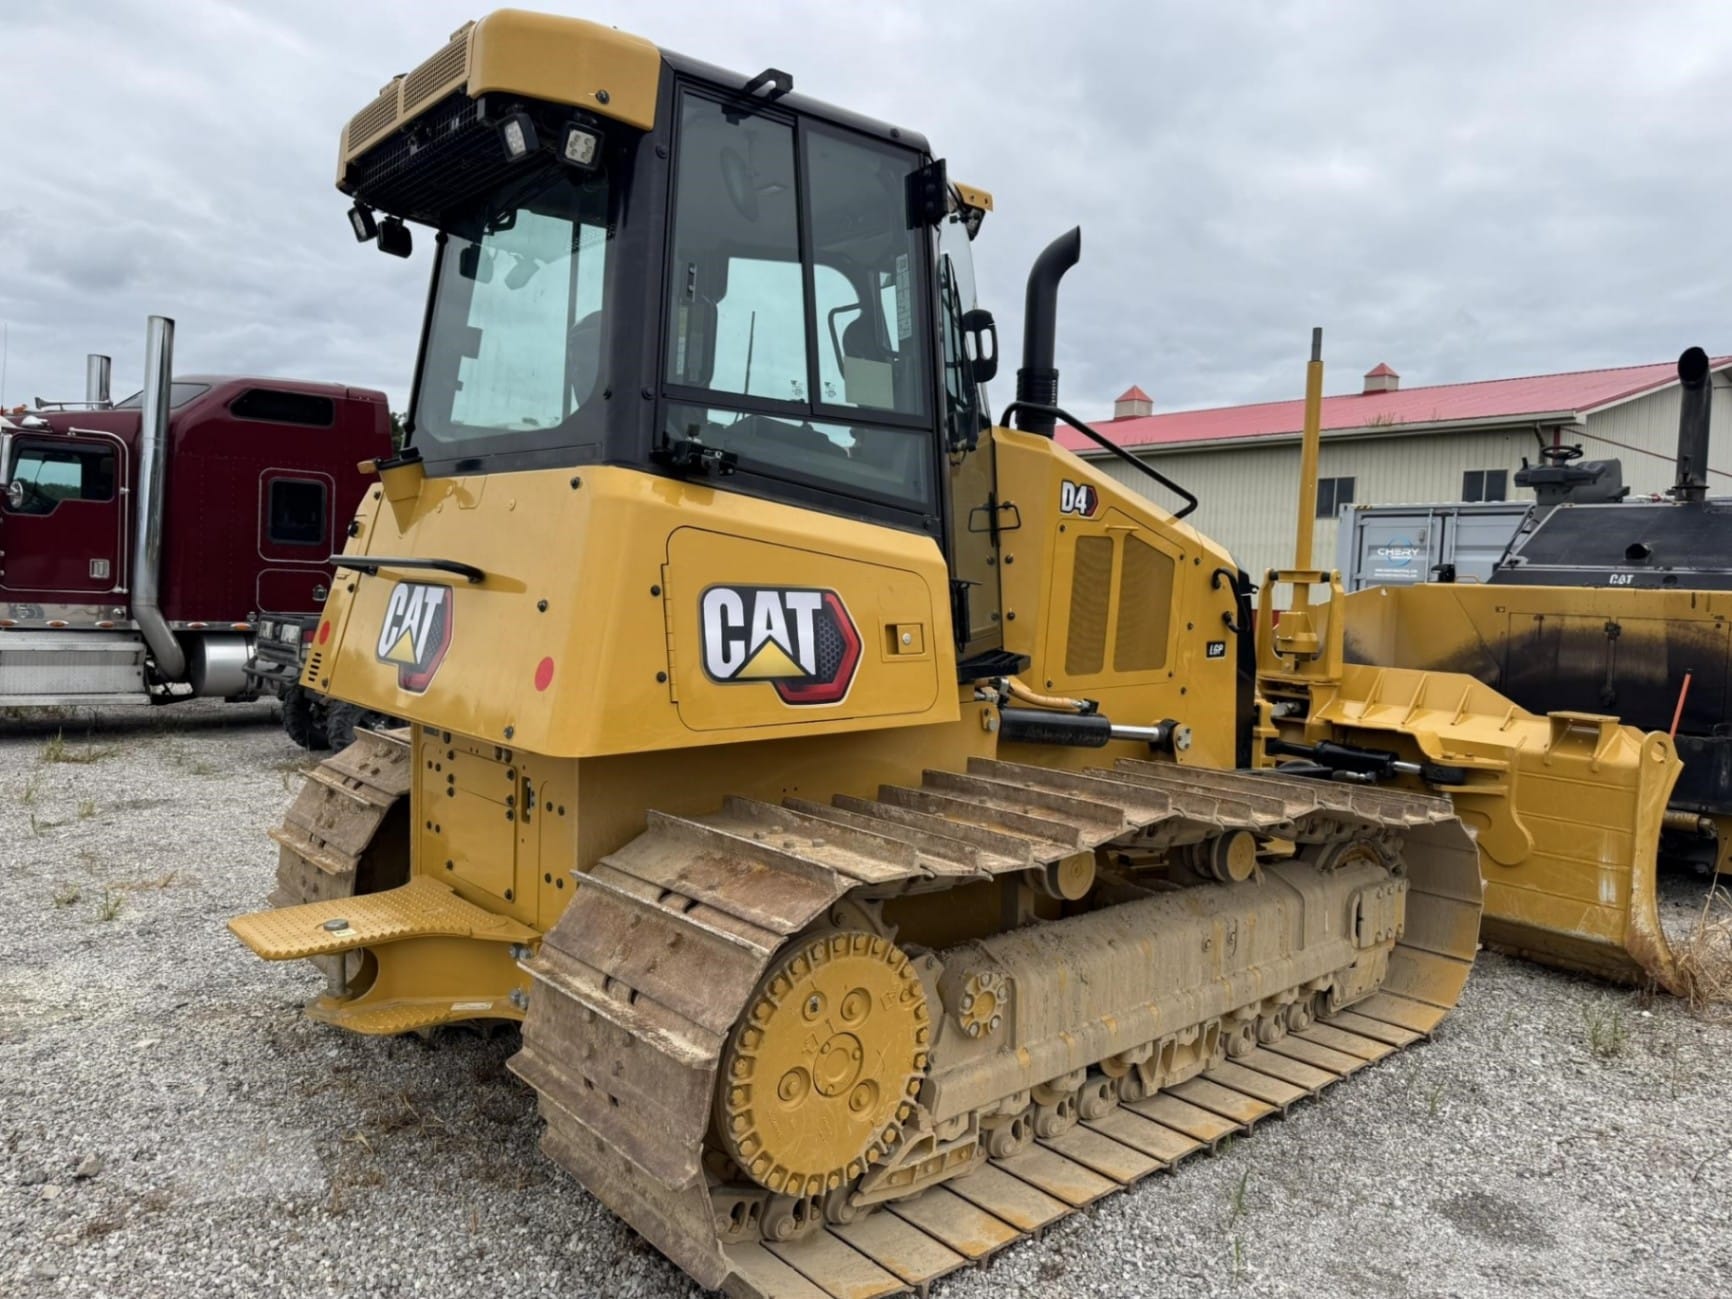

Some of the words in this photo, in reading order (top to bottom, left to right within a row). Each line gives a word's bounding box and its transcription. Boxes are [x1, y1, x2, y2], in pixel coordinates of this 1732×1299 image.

[1061, 480, 1088, 515] D4
[1609, 574, 1635, 585] CAT
[378, 582, 446, 665] CAT
[703, 587, 822, 679] CAT
